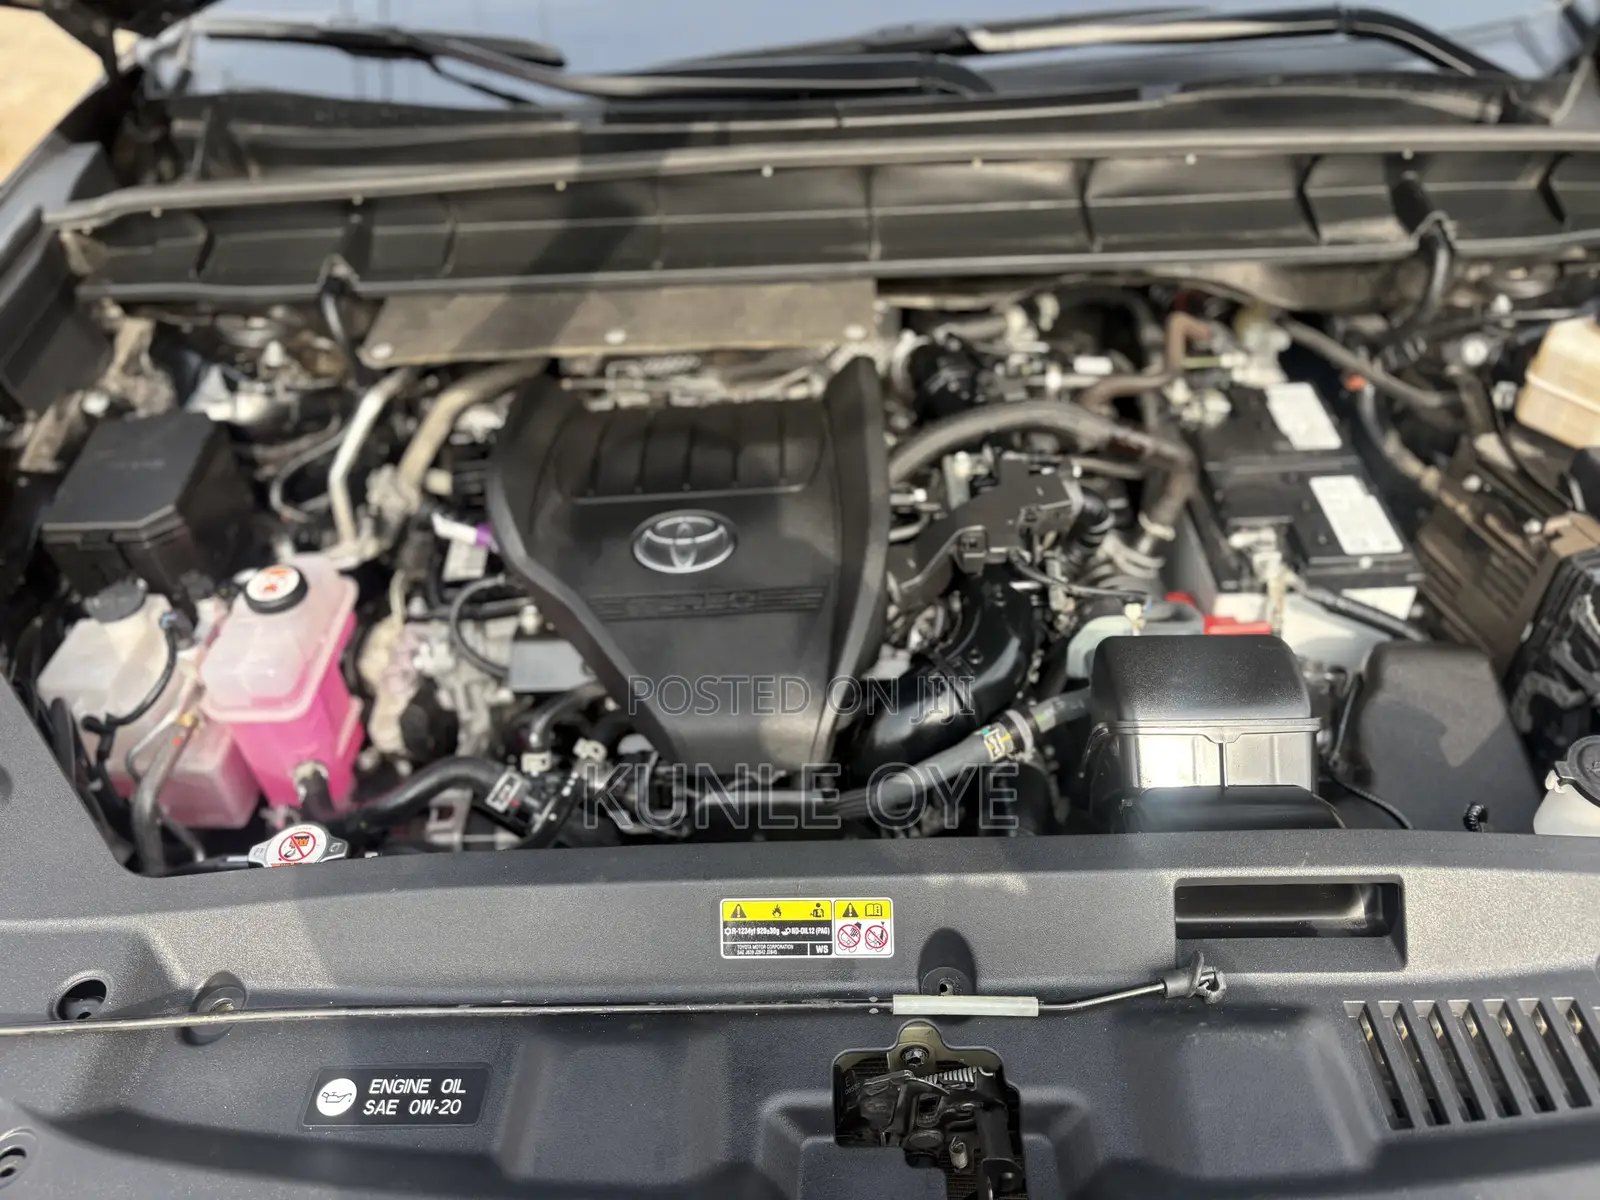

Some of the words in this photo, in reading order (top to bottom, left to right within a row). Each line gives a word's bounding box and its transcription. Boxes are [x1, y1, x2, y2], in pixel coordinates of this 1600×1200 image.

[815, 926, 831, 936] (PAG)
[815, 945, 829, 954] WS
[368, 1078, 432, 1094] ENGINE
[440, 1078, 466, 1094] OIL
[362, 1099, 399, 1115] SAE
[408, 1099, 462, 1115] 0W-20
